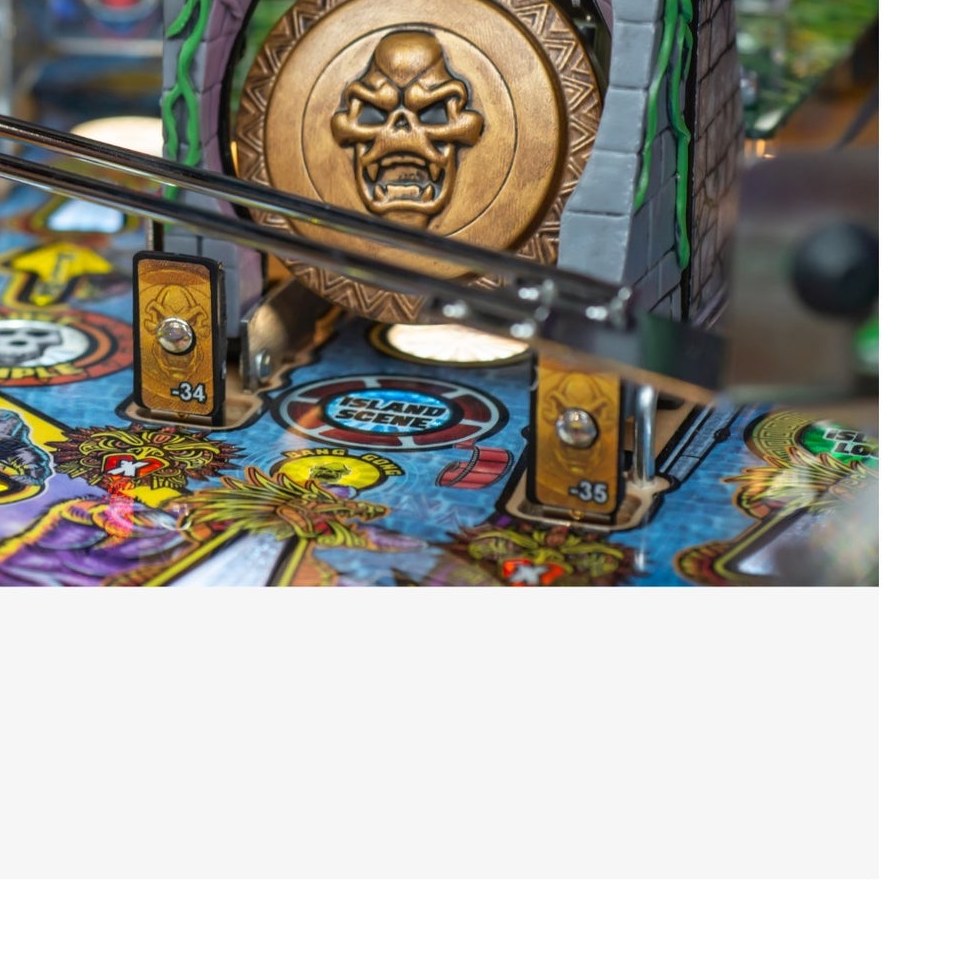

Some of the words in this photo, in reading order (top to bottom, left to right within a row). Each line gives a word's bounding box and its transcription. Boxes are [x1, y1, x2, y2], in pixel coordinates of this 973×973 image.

[170, 381, 207, 403] -34
[339, 395, 448, 418] ISLAND
[335, 409, 434, 429] SCENE
[285, 448, 347, 459] BANG
[832, 441, 878, 458] LO
[569, 480, 608, 504] -35
